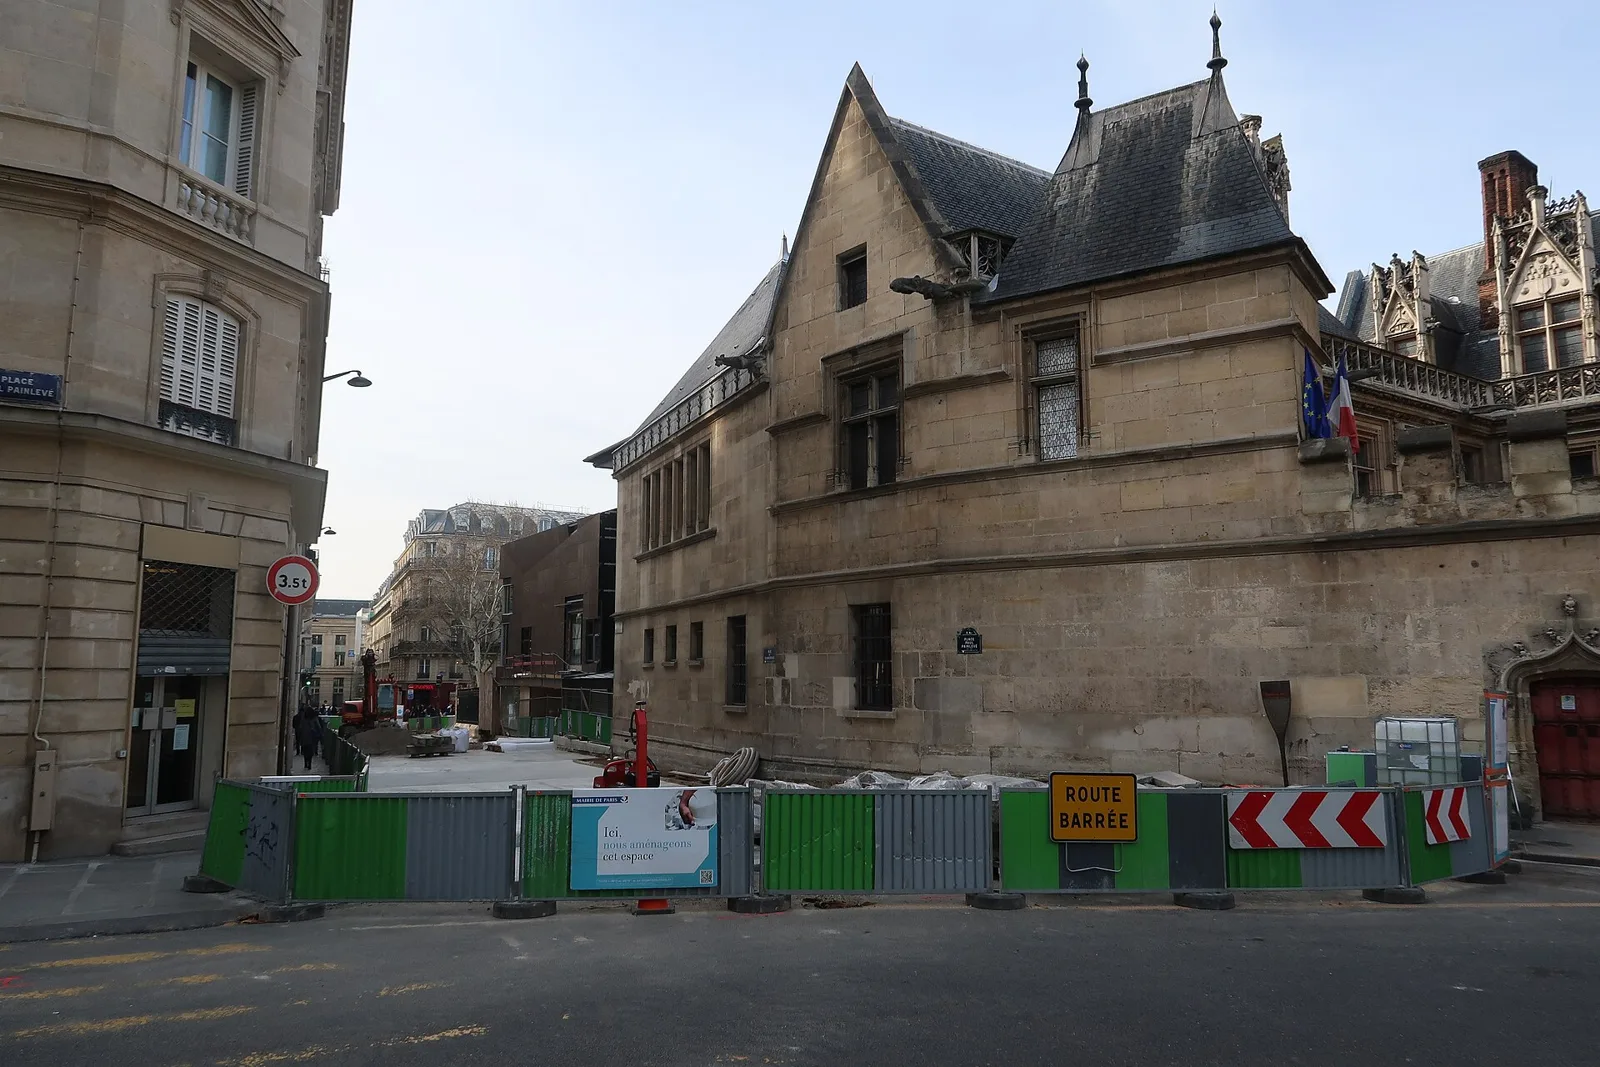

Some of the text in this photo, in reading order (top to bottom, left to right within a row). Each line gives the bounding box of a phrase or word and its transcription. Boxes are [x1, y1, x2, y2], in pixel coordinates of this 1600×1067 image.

[2, 376, 34, 386] PLACE
[1066, 786, 1121, 803] ROUTE
[1060, 809, 1129, 829] BARRÉE
[603, 826, 622, 838] Ici,
[603, 839, 692, 851] nous aménageons
[602, 852, 654, 864] cet espace
